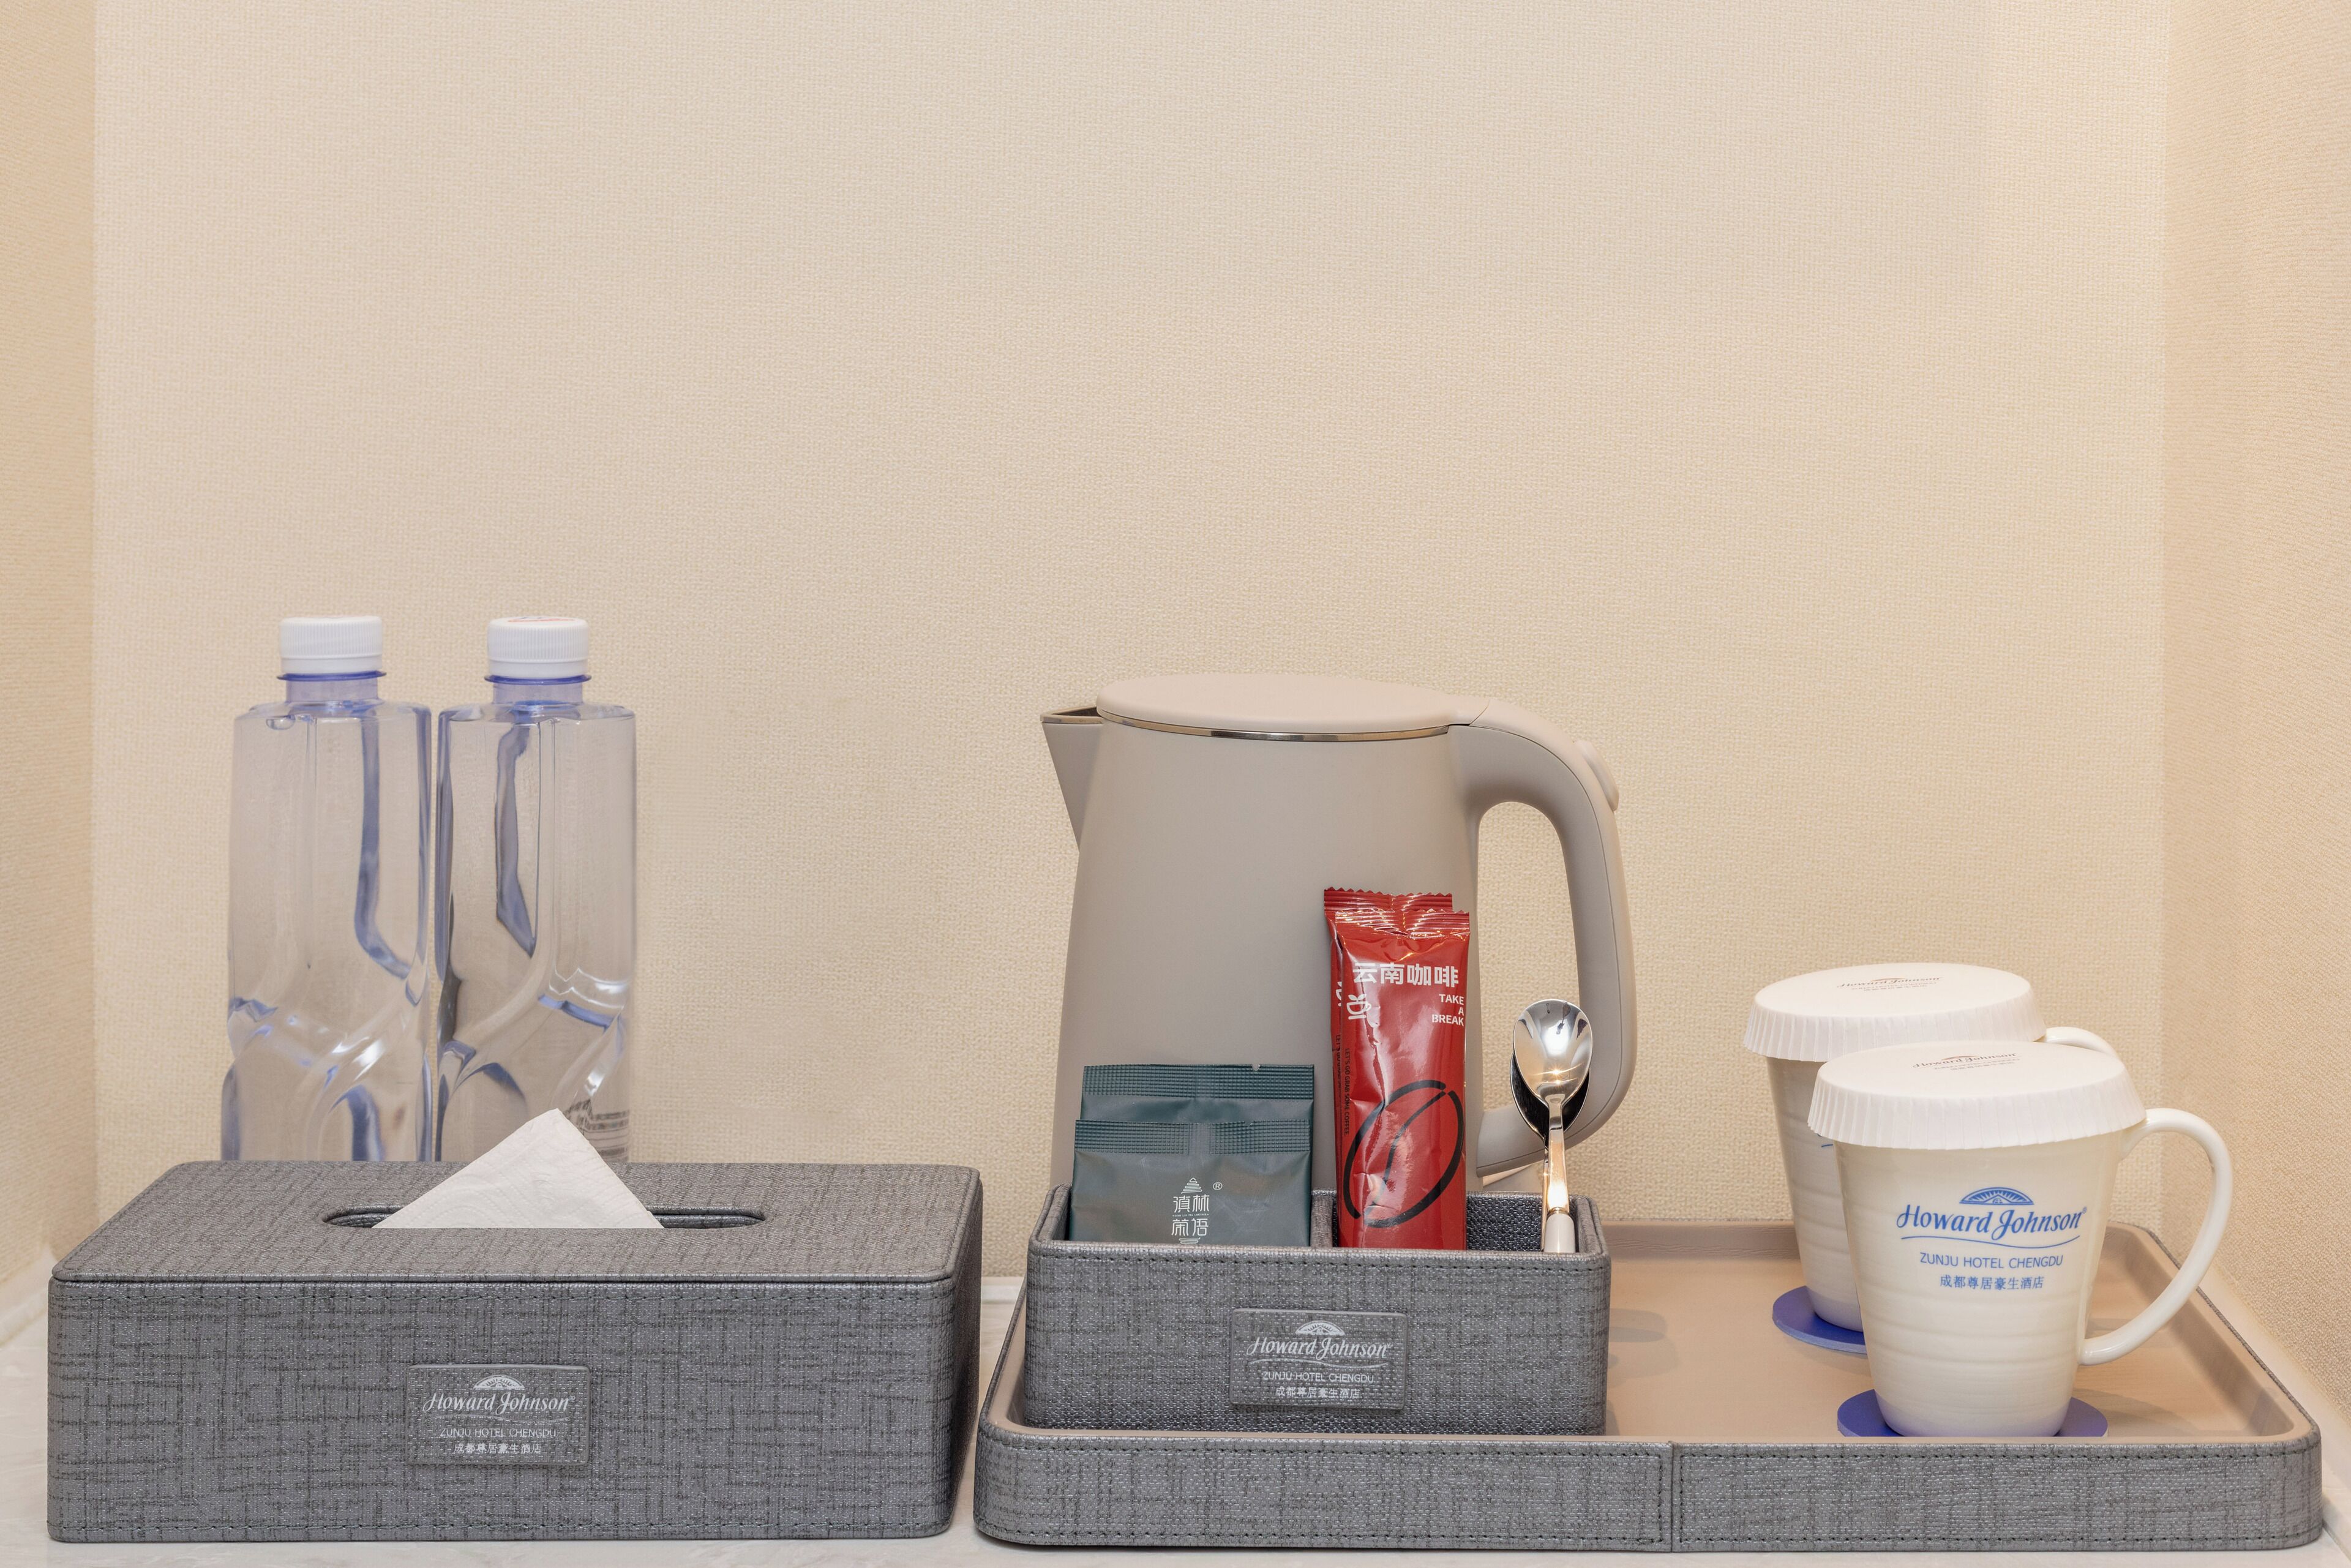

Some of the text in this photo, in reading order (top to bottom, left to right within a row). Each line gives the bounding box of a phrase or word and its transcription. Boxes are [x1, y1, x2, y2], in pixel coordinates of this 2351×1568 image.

[1352, 962, 1460, 988] 云南咖啡
[1439, 994, 1464, 1005] TAKE
[1458, 1007, 1464, 1016] A
[1431, 1014, 1464, 1026] BREAK
[1344, 1065, 1351, 1075] GO
[1896, 1204, 1993, 1233] Howard
[1919, 1252, 2064, 1269] ZUNJU HOTEL CHENGDU
[1940, 1274, 2044, 1291] 成都尊居豪生酒店
[1246, 1337, 1318, 1356] Howard
[1262, 1371, 1374, 1384] ZUNJU HOTEL CHENGDU
[422, 1392, 496, 1412] Howard
[440, 1427, 557, 1438] ZUNJU HOTEL CHENGDU
